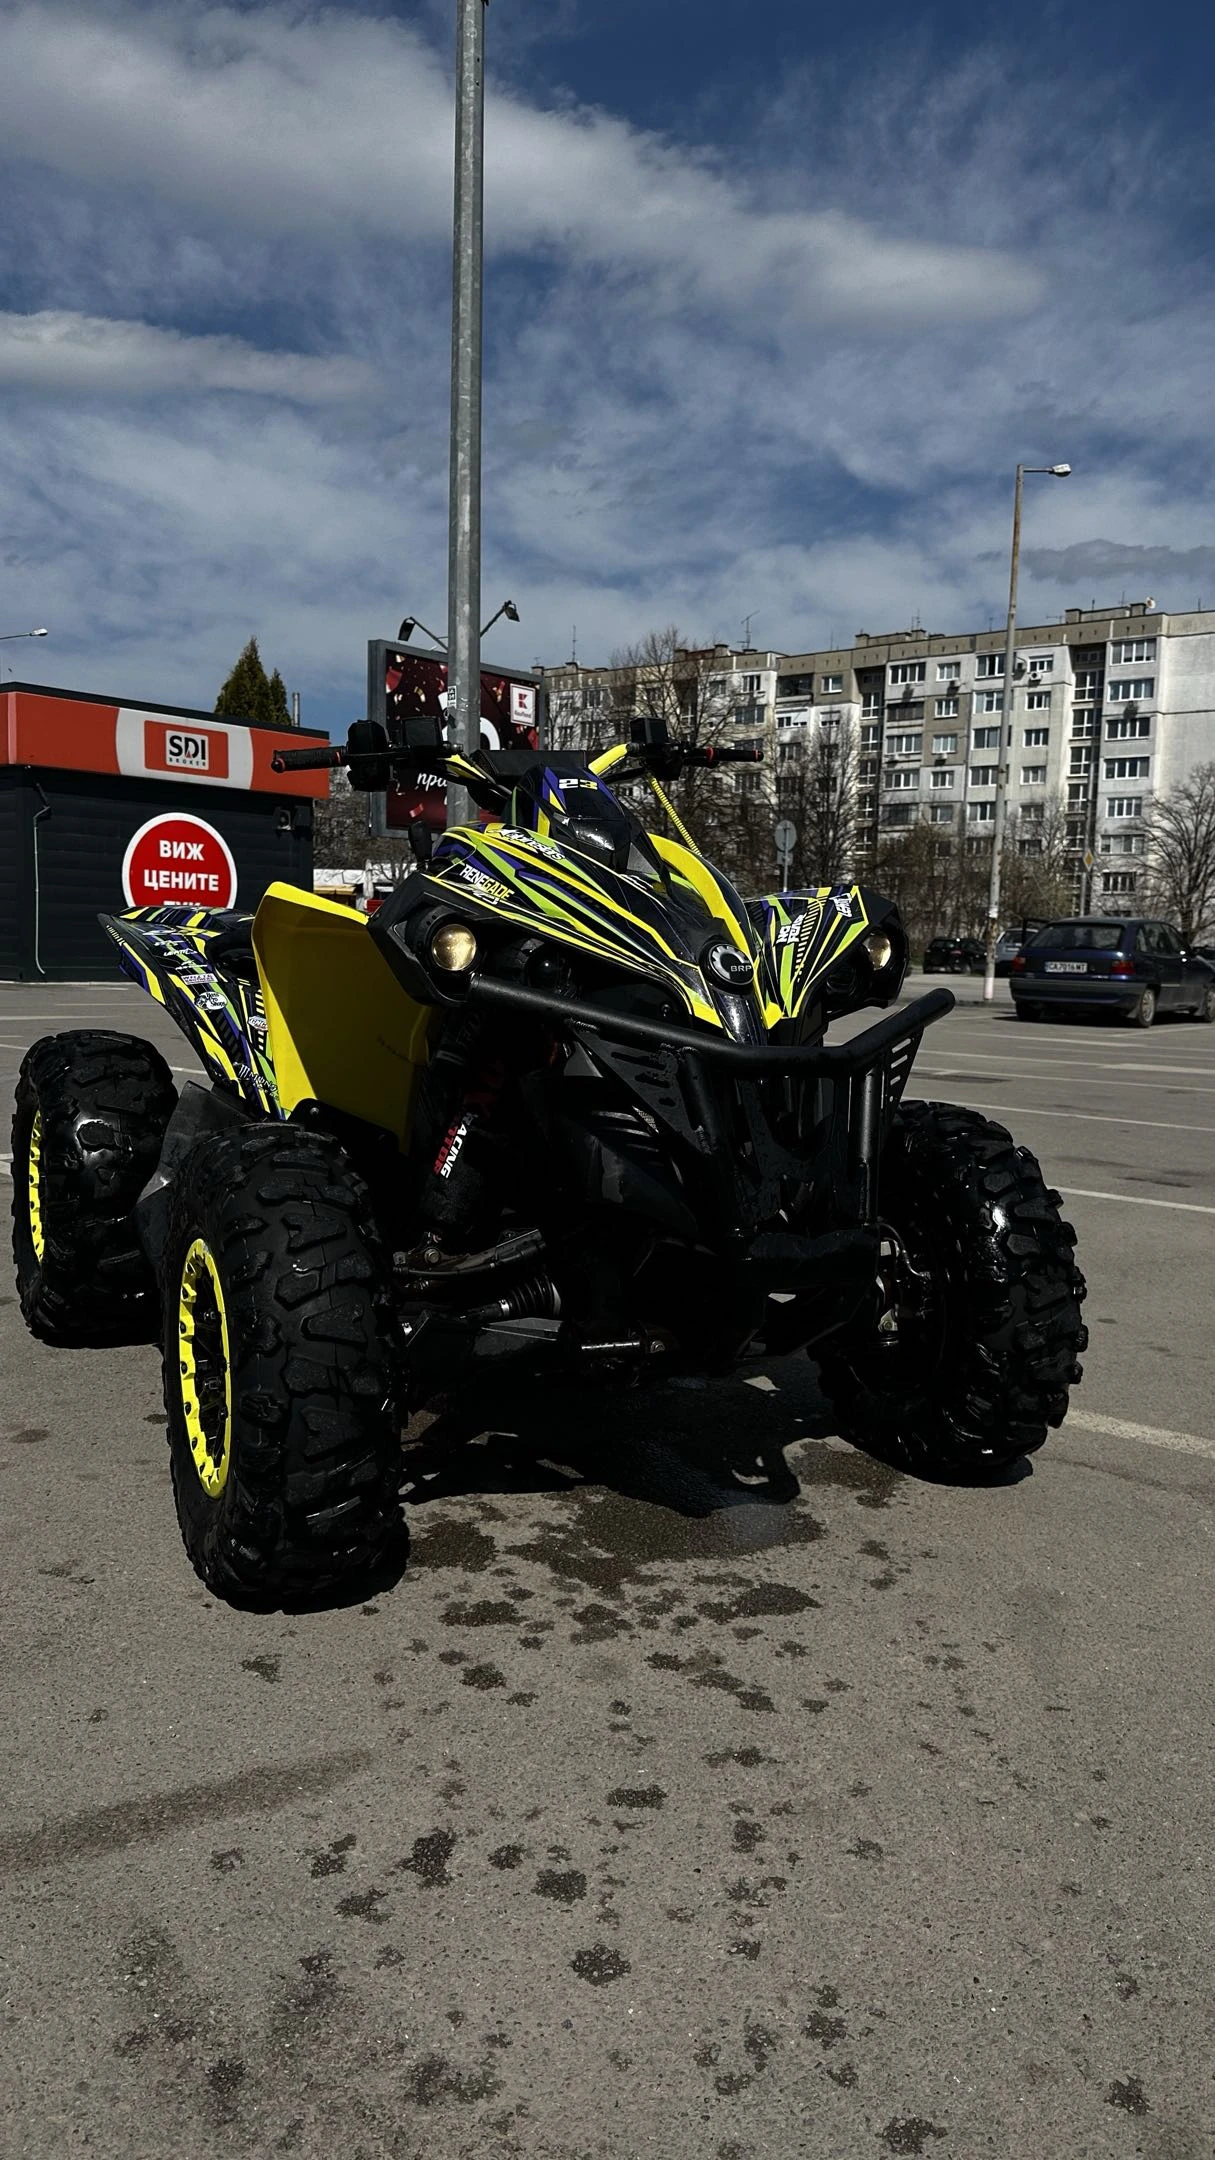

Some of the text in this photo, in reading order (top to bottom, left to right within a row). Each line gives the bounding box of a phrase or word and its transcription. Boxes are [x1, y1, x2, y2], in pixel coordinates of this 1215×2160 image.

[169, 735, 206, 760] SDI
[559, 779, 598, 790] 23
[159, 840, 204, 861] ВИЖ
[144, 869, 219, 892] ЦЕНИТЕ
[459, 864, 515, 900] RENEGADE
